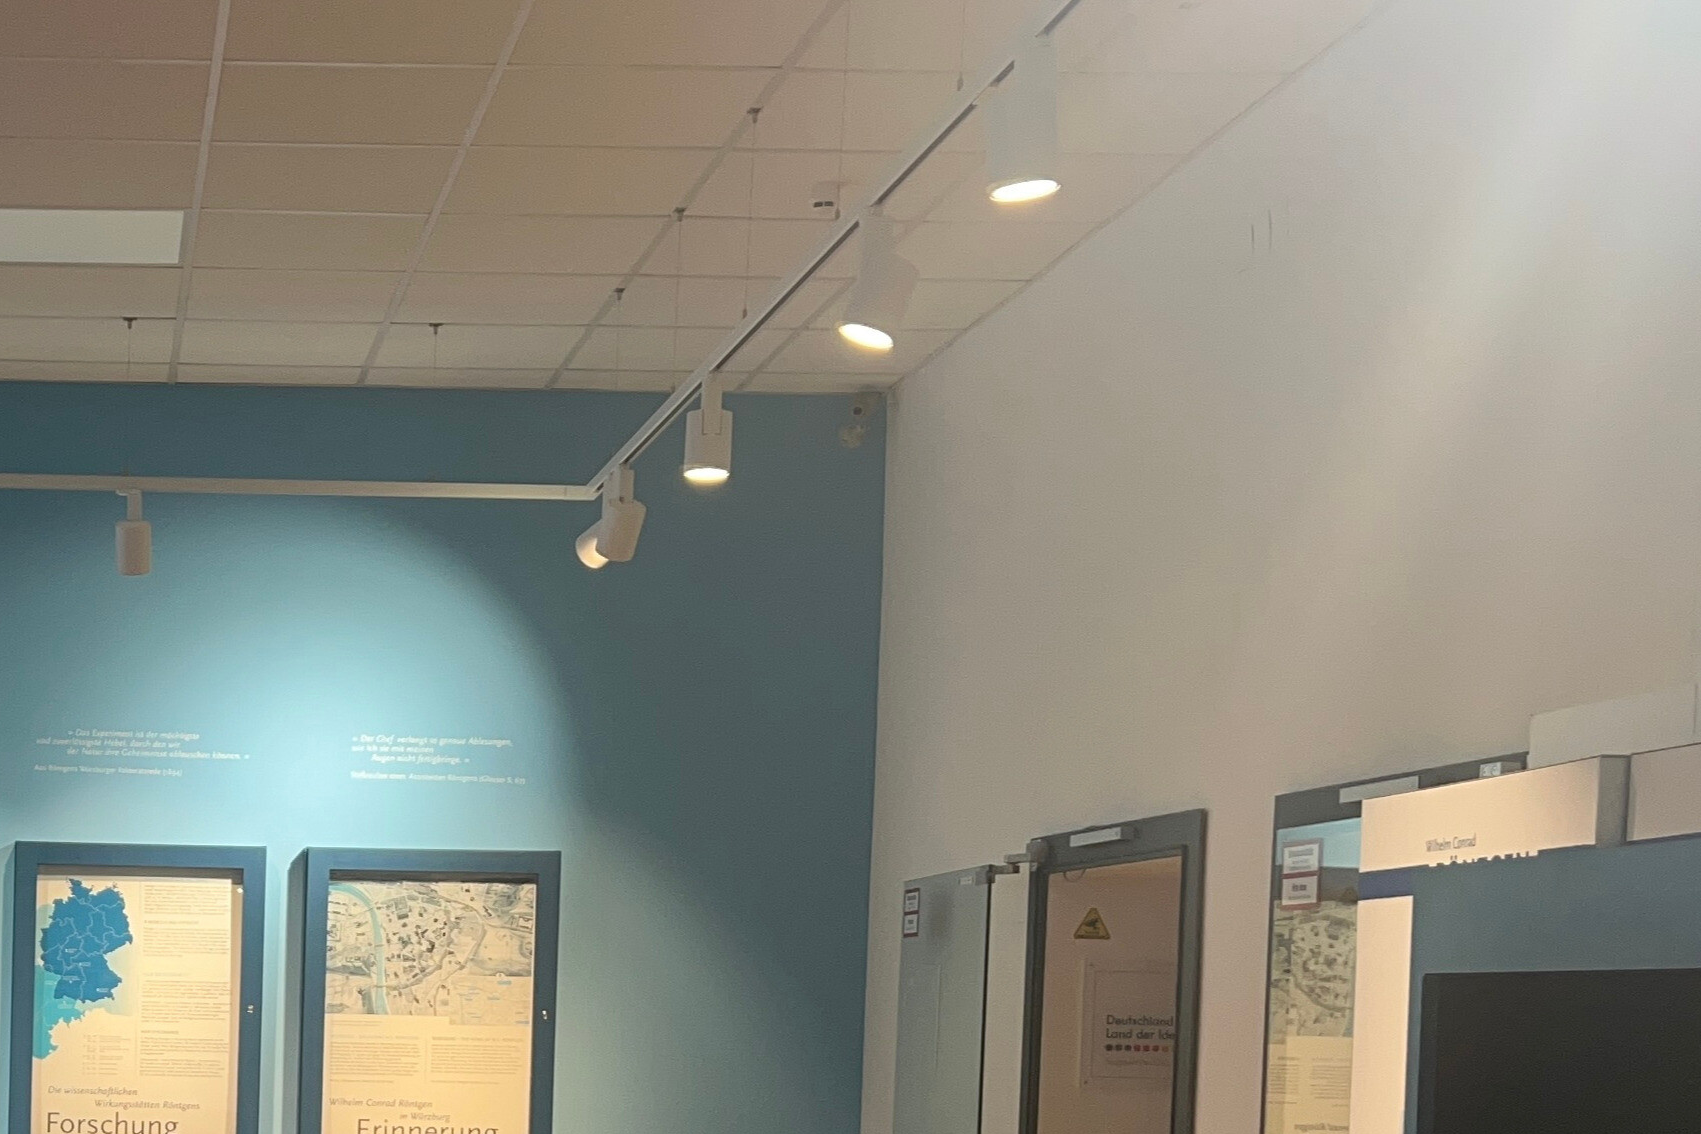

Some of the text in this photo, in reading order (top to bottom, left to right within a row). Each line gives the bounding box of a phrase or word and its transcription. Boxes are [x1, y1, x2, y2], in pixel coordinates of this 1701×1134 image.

[1106, 1014, 1174, 1026] Deutschland
[1106, 1028, 1133, 1039] Land
[1136, 1029, 1155, 1039] der
[64, 1087, 137, 1097] wissenschaftlichen
[162, 1100, 200, 1112] Röntgens
[329, 1097, 432, 1110] Wilhelm Conrad Röntgen
[410, 1112, 451, 1123] Würzburg
